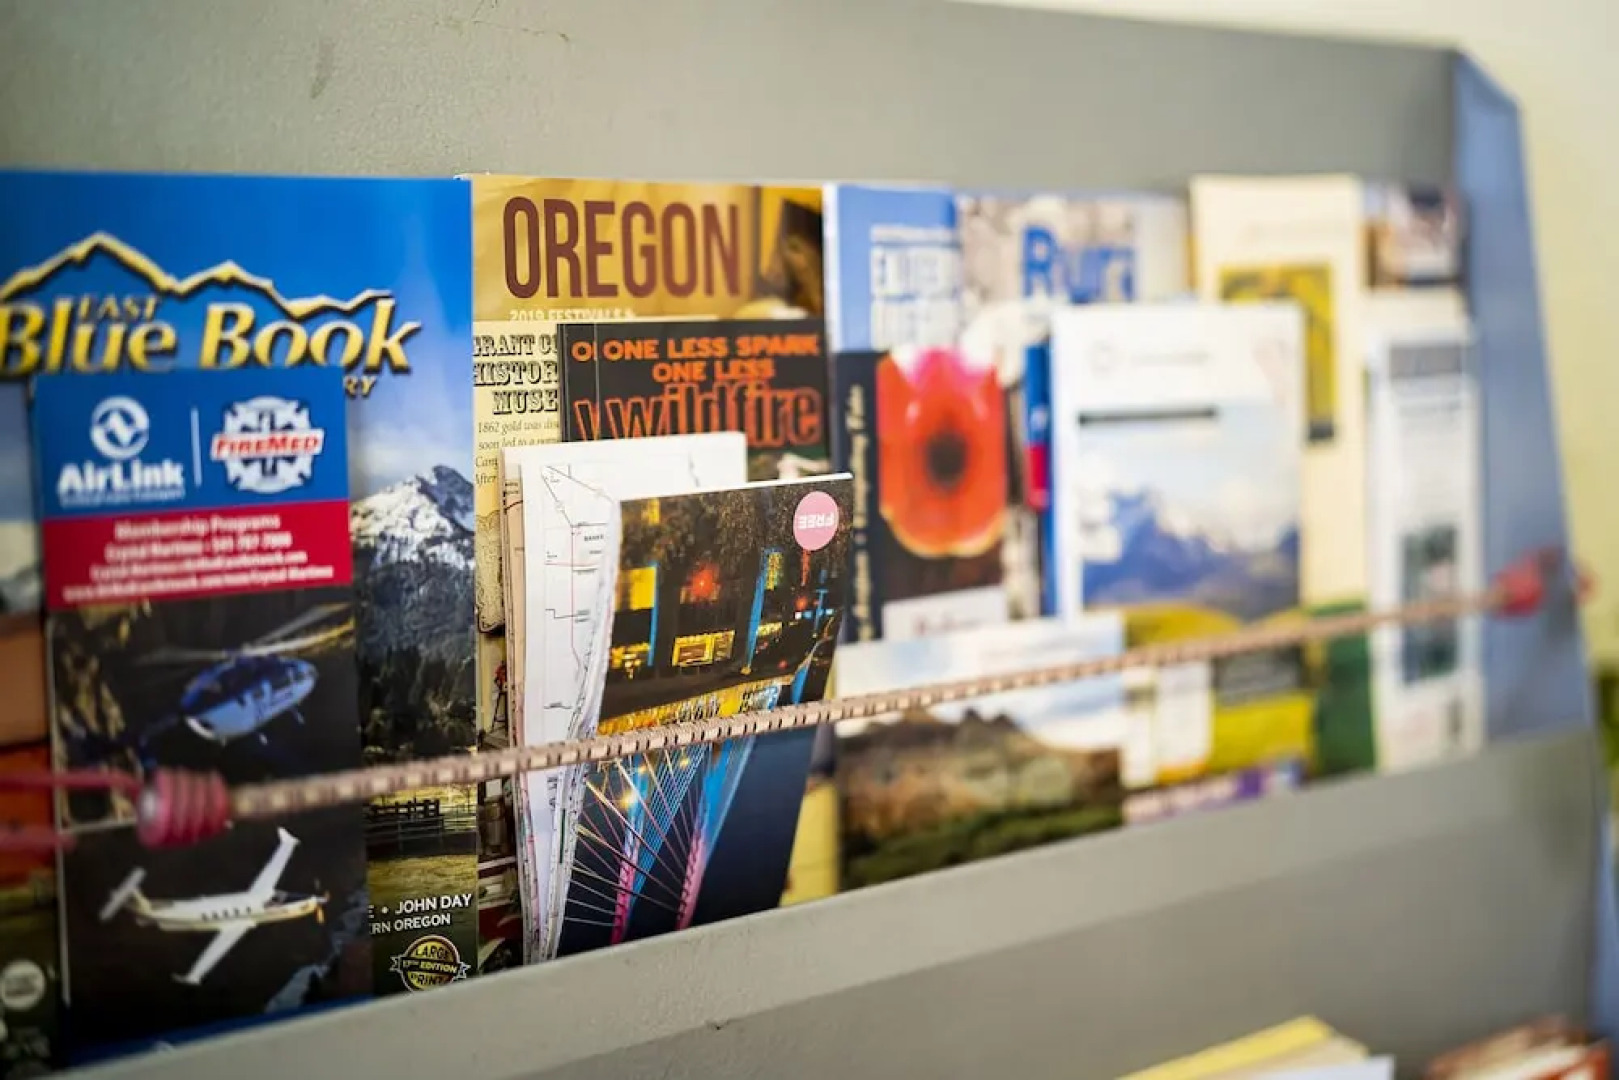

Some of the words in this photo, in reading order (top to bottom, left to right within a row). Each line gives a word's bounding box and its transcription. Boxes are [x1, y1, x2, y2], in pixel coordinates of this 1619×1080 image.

[502, 196, 742, 299] OREGON
[78, 294, 159, 322] EAST
[0, 300, 178, 374] Blue
[200, 298, 422, 372] Book
[603, 339, 660, 361] ONE
[667, 336, 728, 359] LESS
[735, 333, 821, 357] SPARK
[652, 360, 707, 383] ONE
[713, 357, 776, 381] LESS
[493, 389, 558, 415] MUSE
[478, 421, 500, 433] 1862
[501, 419, 522, 436] gold
[478, 440, 500, 450] soon
[58, 459, 184, 496] AirLink
[798, 511, 836, 530] FREE
[395, 897, 438, 916] JOHN
[440, 893, 473, 910] DAY
[394, 912, 452, 932] OREGON
[420, 961, 458, 974] EDITION
